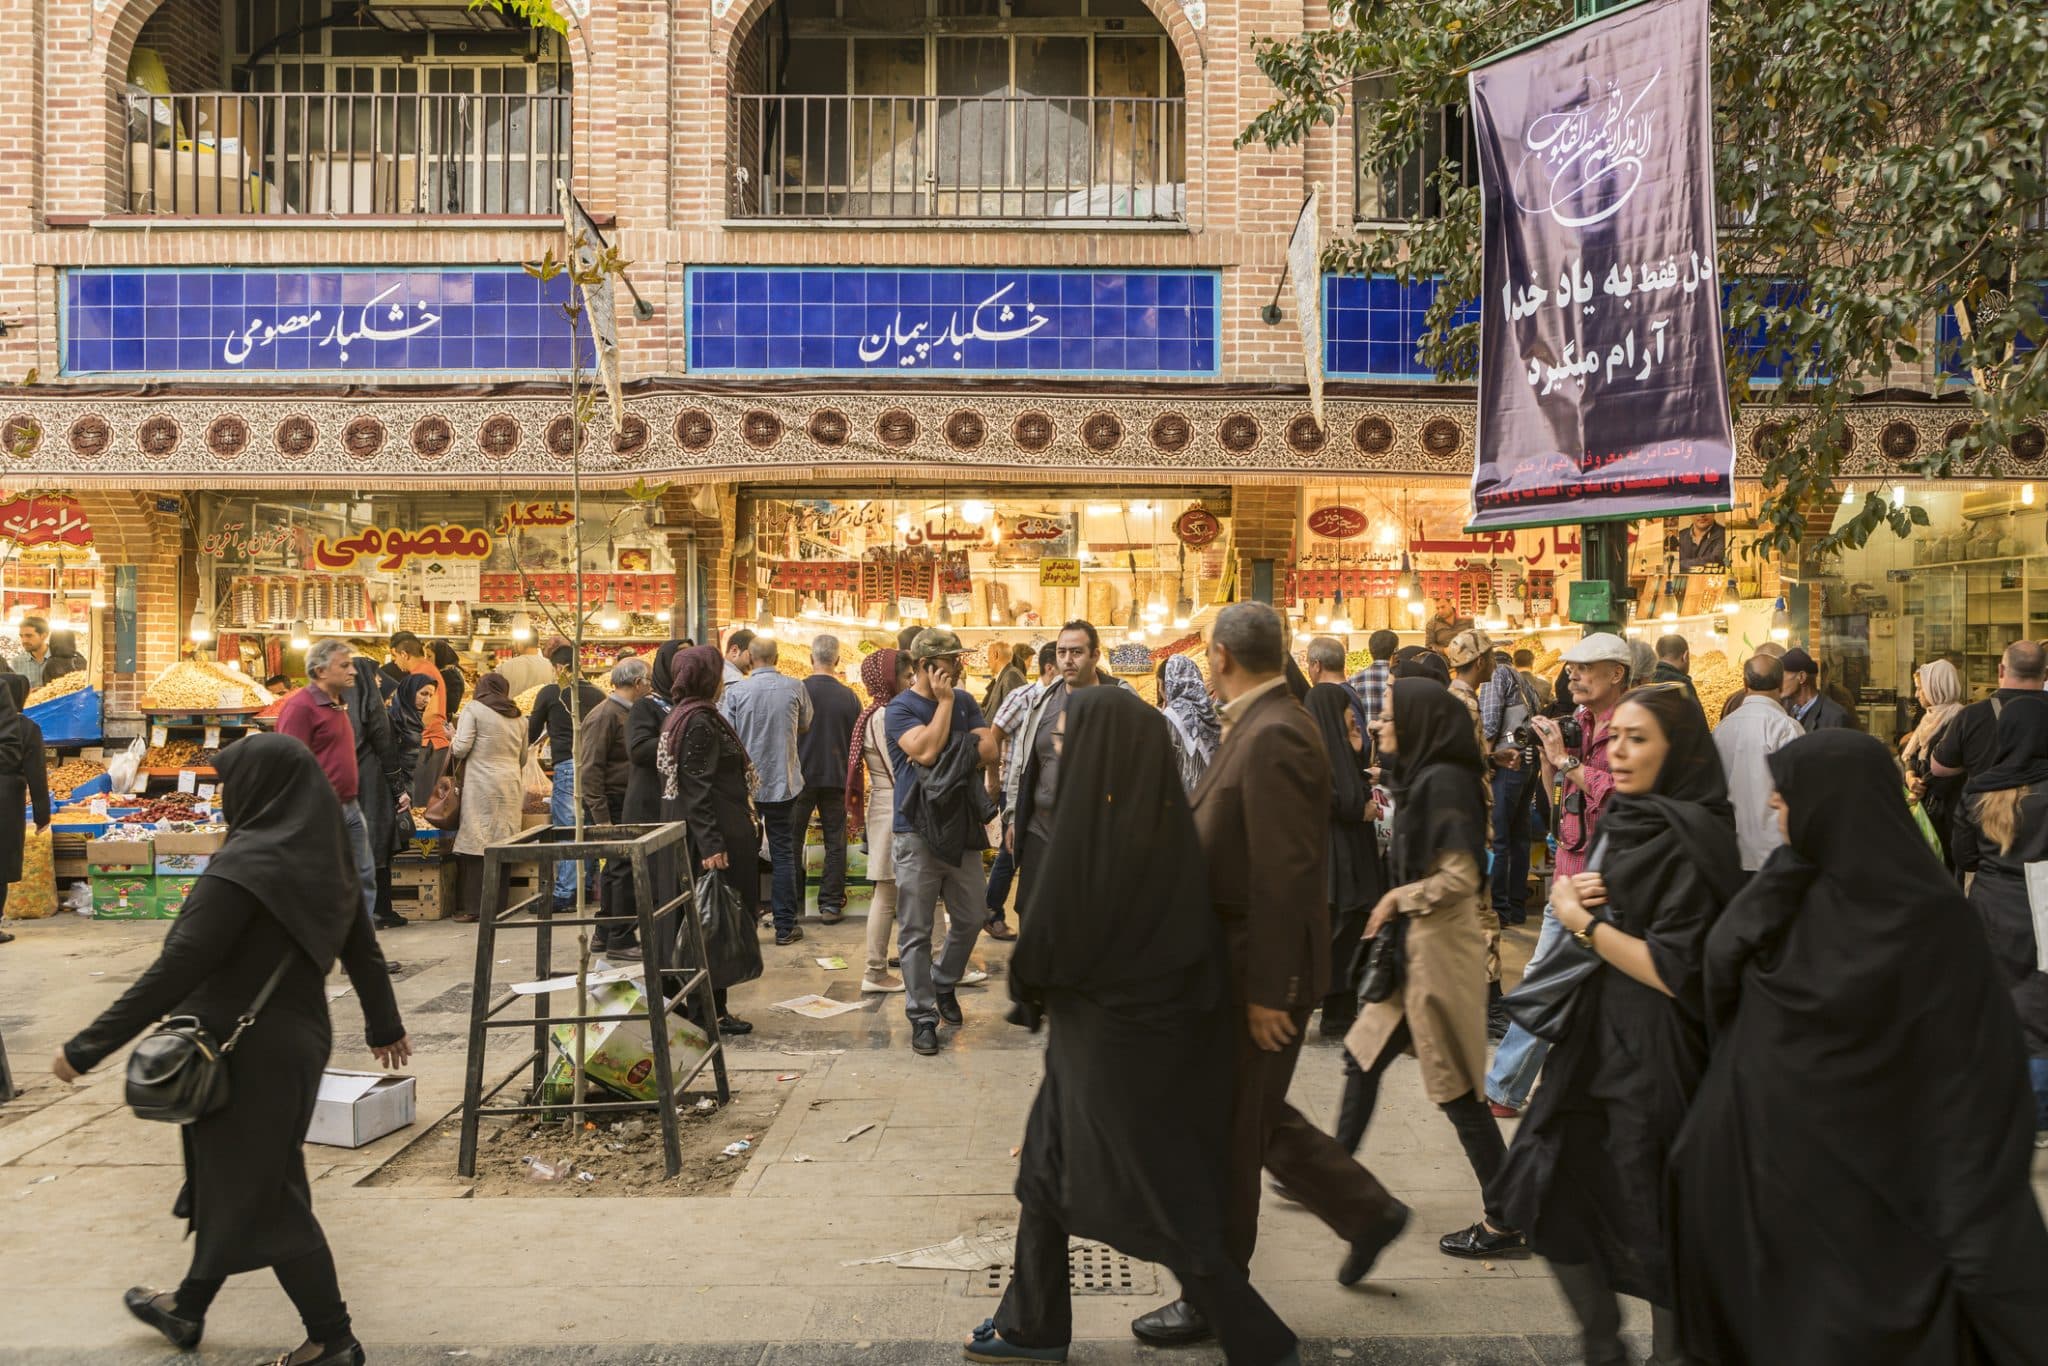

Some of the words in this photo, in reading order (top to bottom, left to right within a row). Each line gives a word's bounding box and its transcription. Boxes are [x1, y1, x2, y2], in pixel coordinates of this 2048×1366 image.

[1502, 269, 1549, 323] خدا
[1555, 257, 1596, 316] یاد
[1602, 262, 1633, 310] به
[1637, 253, 1678, 293] فقط
[1682, 250, 1713, 293] دل
[224, 310, 322, 364] معصومی
[318, 282, 441, 363] خشکبار
[858, 311, 929, 366] پیمان
[933, 281, 1049, 361] خشکبار
[1527, 339, 1600, 396] میگیرد
[1604, 319, 1670, 384] آرام
[496, 502, 576, 535] خشکبار
[905, 519, 985, 550] پیمان
[314, 524, 492, 573] معصومی
